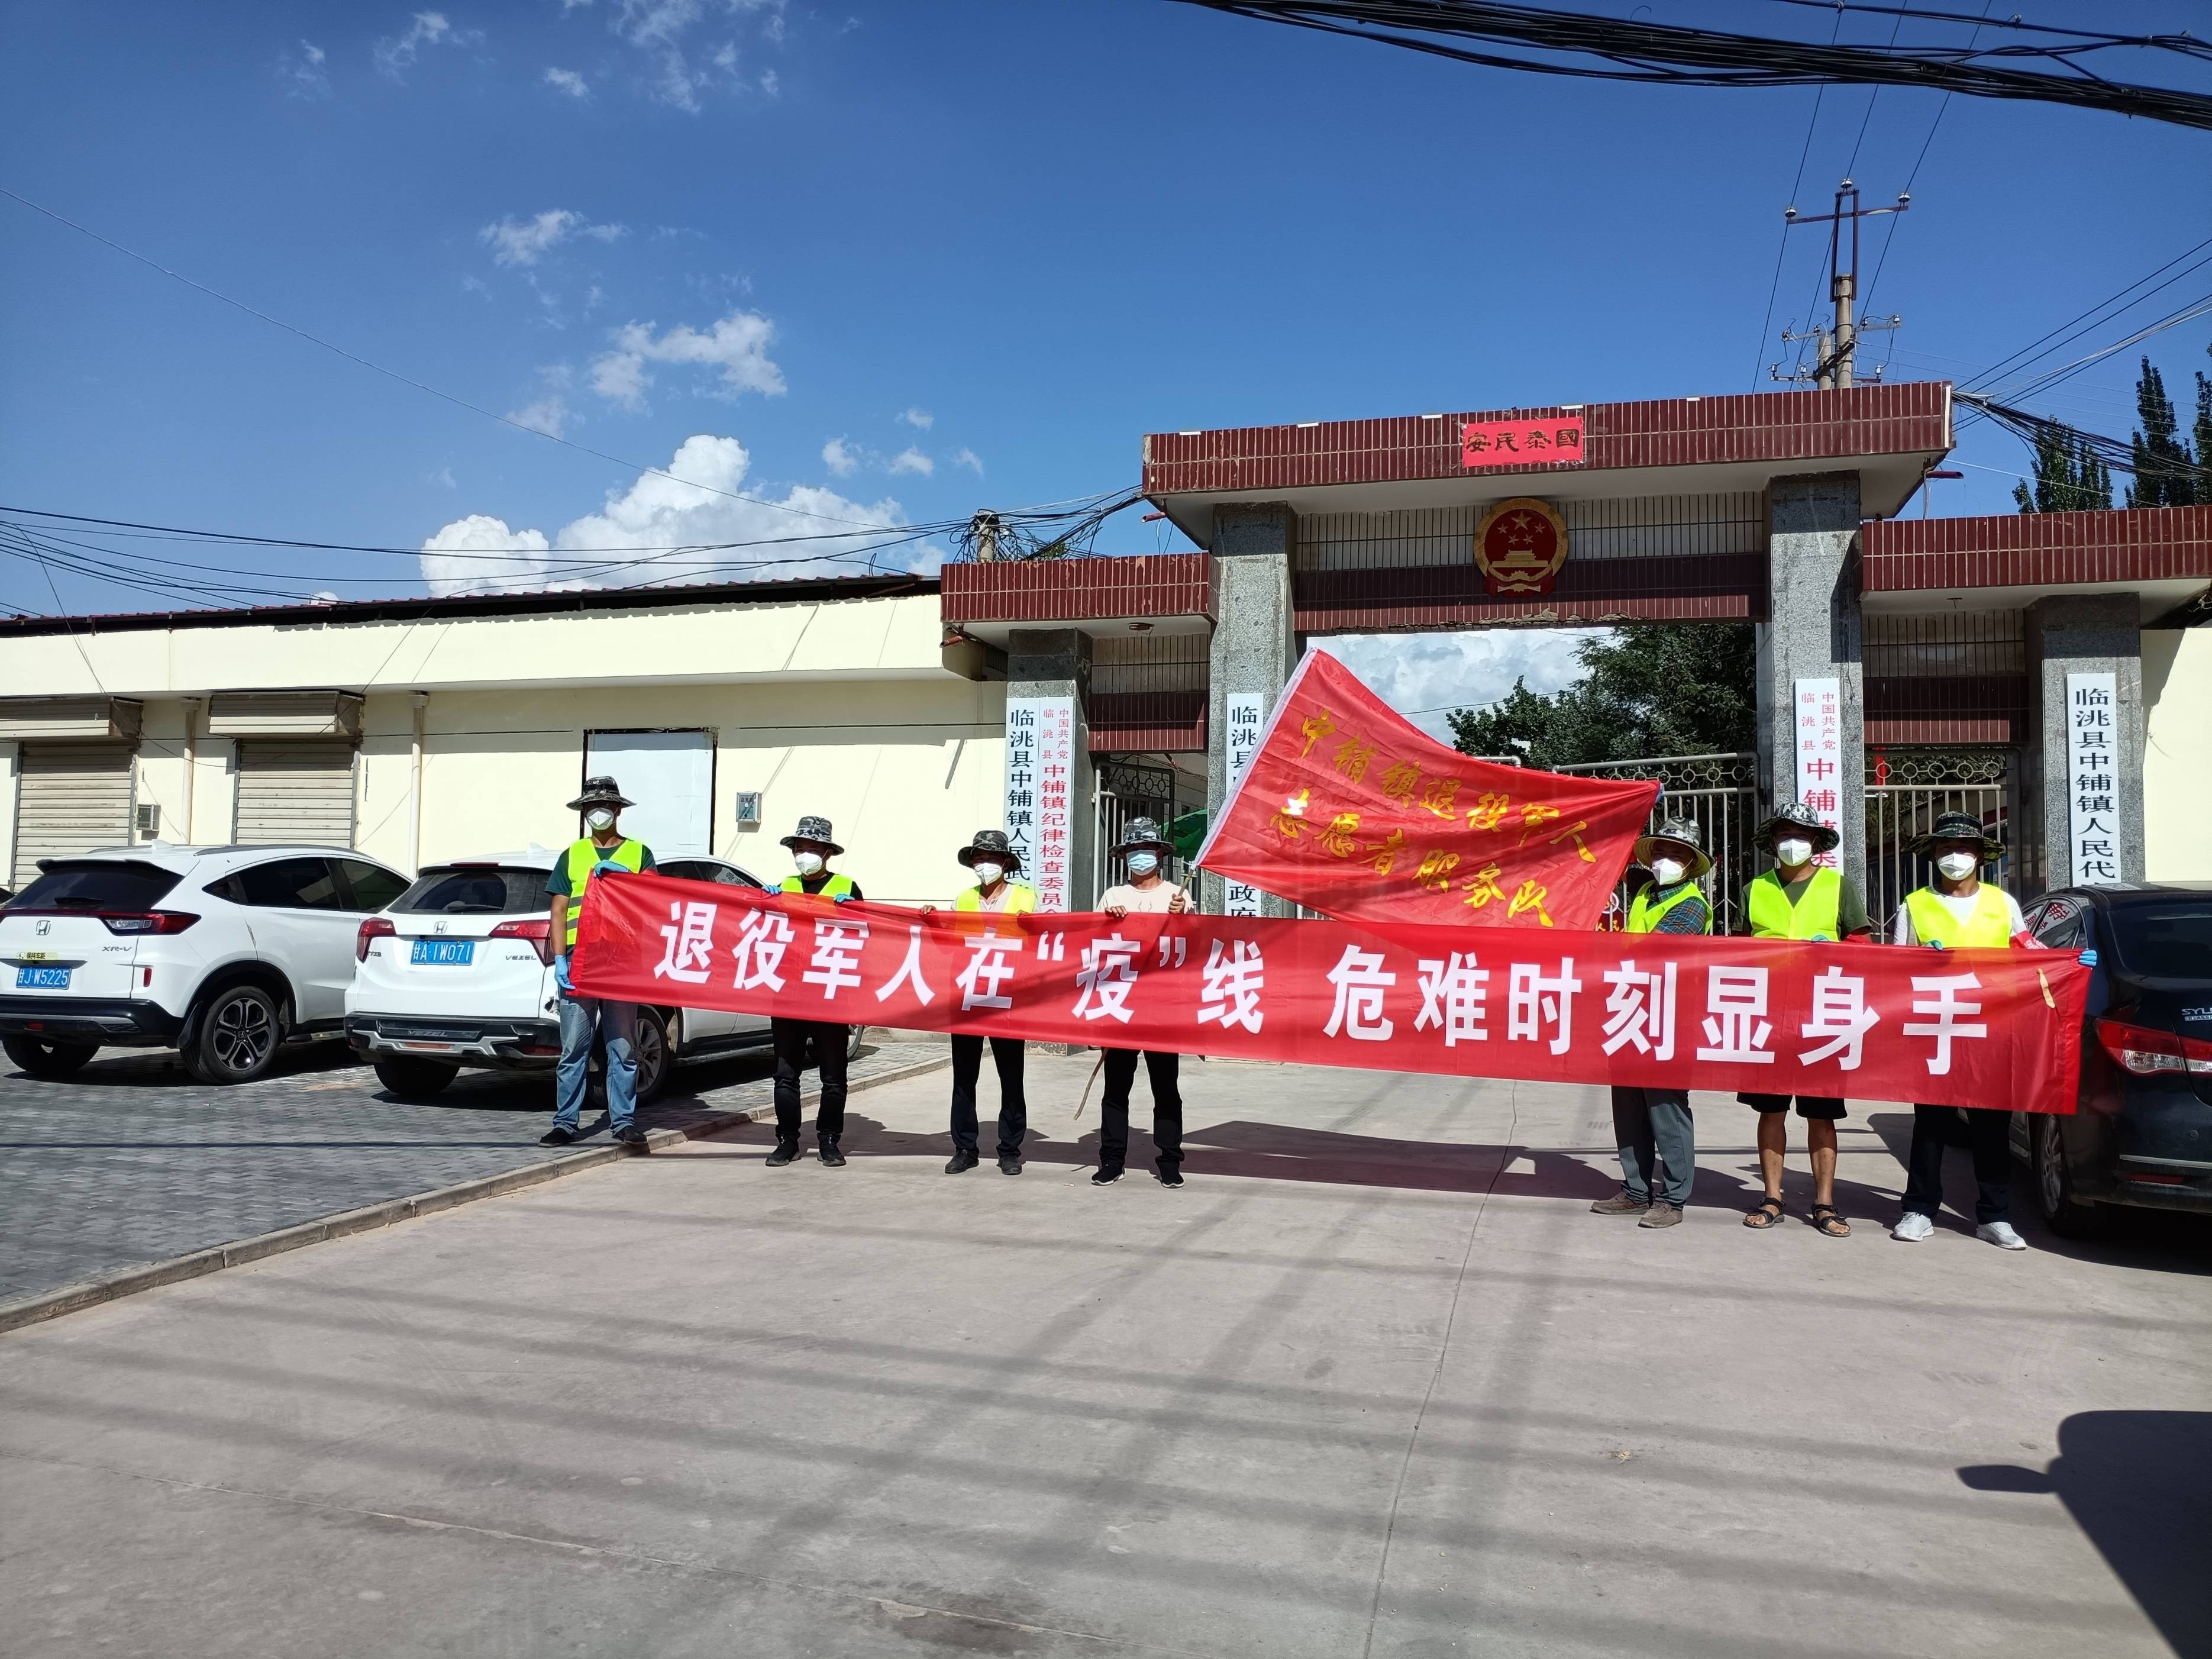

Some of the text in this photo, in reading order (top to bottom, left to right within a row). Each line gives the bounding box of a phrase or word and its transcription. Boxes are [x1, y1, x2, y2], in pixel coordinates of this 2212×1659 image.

[1042, 709, 1054, 759] 临洮县
[1057, 709, 1069, 759] 中国共产党
[1231, 706, 1258, 783] 临洮县
[1801, 693, 1816, 750] 临洮县
[1822, 692, 1836, 750] 中国共产党
[1007, 709, 1035, 889] 临洮县中铺镇人民武
[1039, 764, 1067, 913] 中铺镇纪律检查委员
[1803, 758, 1838, 868] 中铺委
[2075, 688, 2116, 887] 临洮县中铺镇人民代
[1270, 787, 1554, 928] 志愿者服务队
[1323, 944, 1988, 1076] 危难时刻显身手
